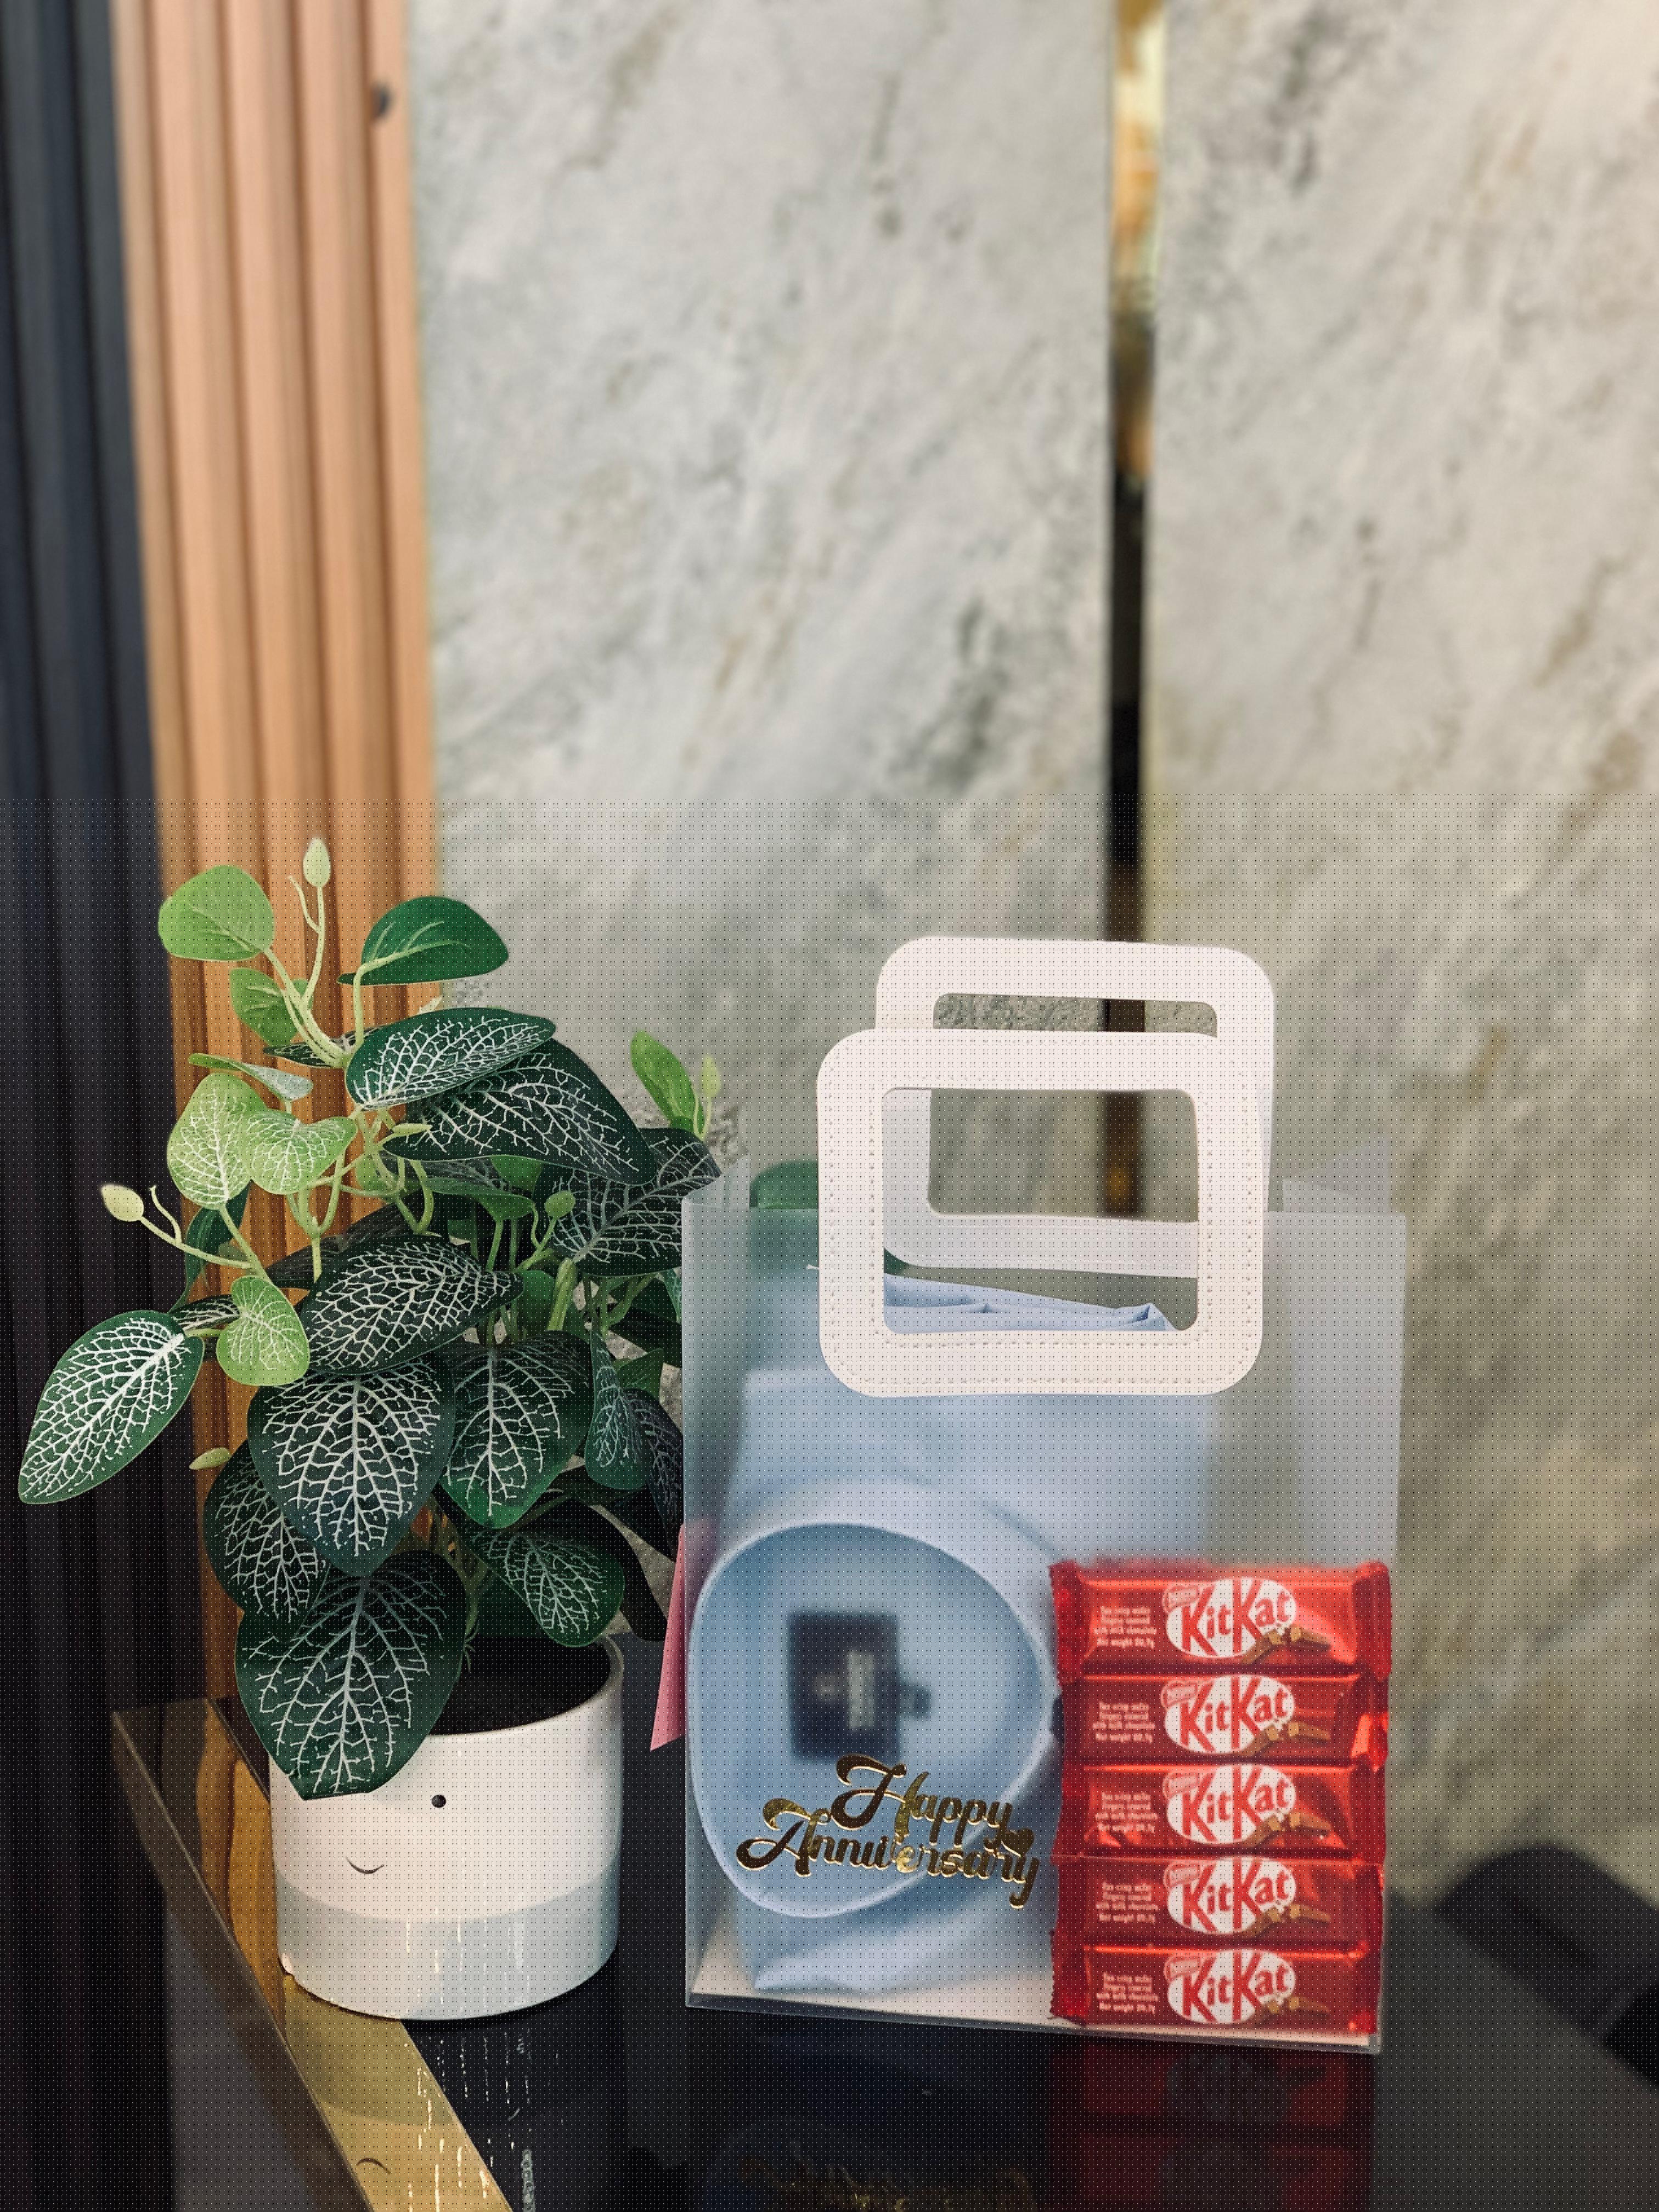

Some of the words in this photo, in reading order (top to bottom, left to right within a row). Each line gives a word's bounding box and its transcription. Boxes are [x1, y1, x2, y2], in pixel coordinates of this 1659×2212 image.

[1181, 1579, 1290, 1656] KitKat
[1180, 1675, 1288, 1752] KitKat
[830, 1754, 1013, 1852] Happy
[1181, 1764, 1290, 1842] KitKat
[736, 1798, 1040, 1909] Anniversary
[1182, 1857, 1290, 1932] KitKat
[1182, 1950, 1290, 2022] KitKat
